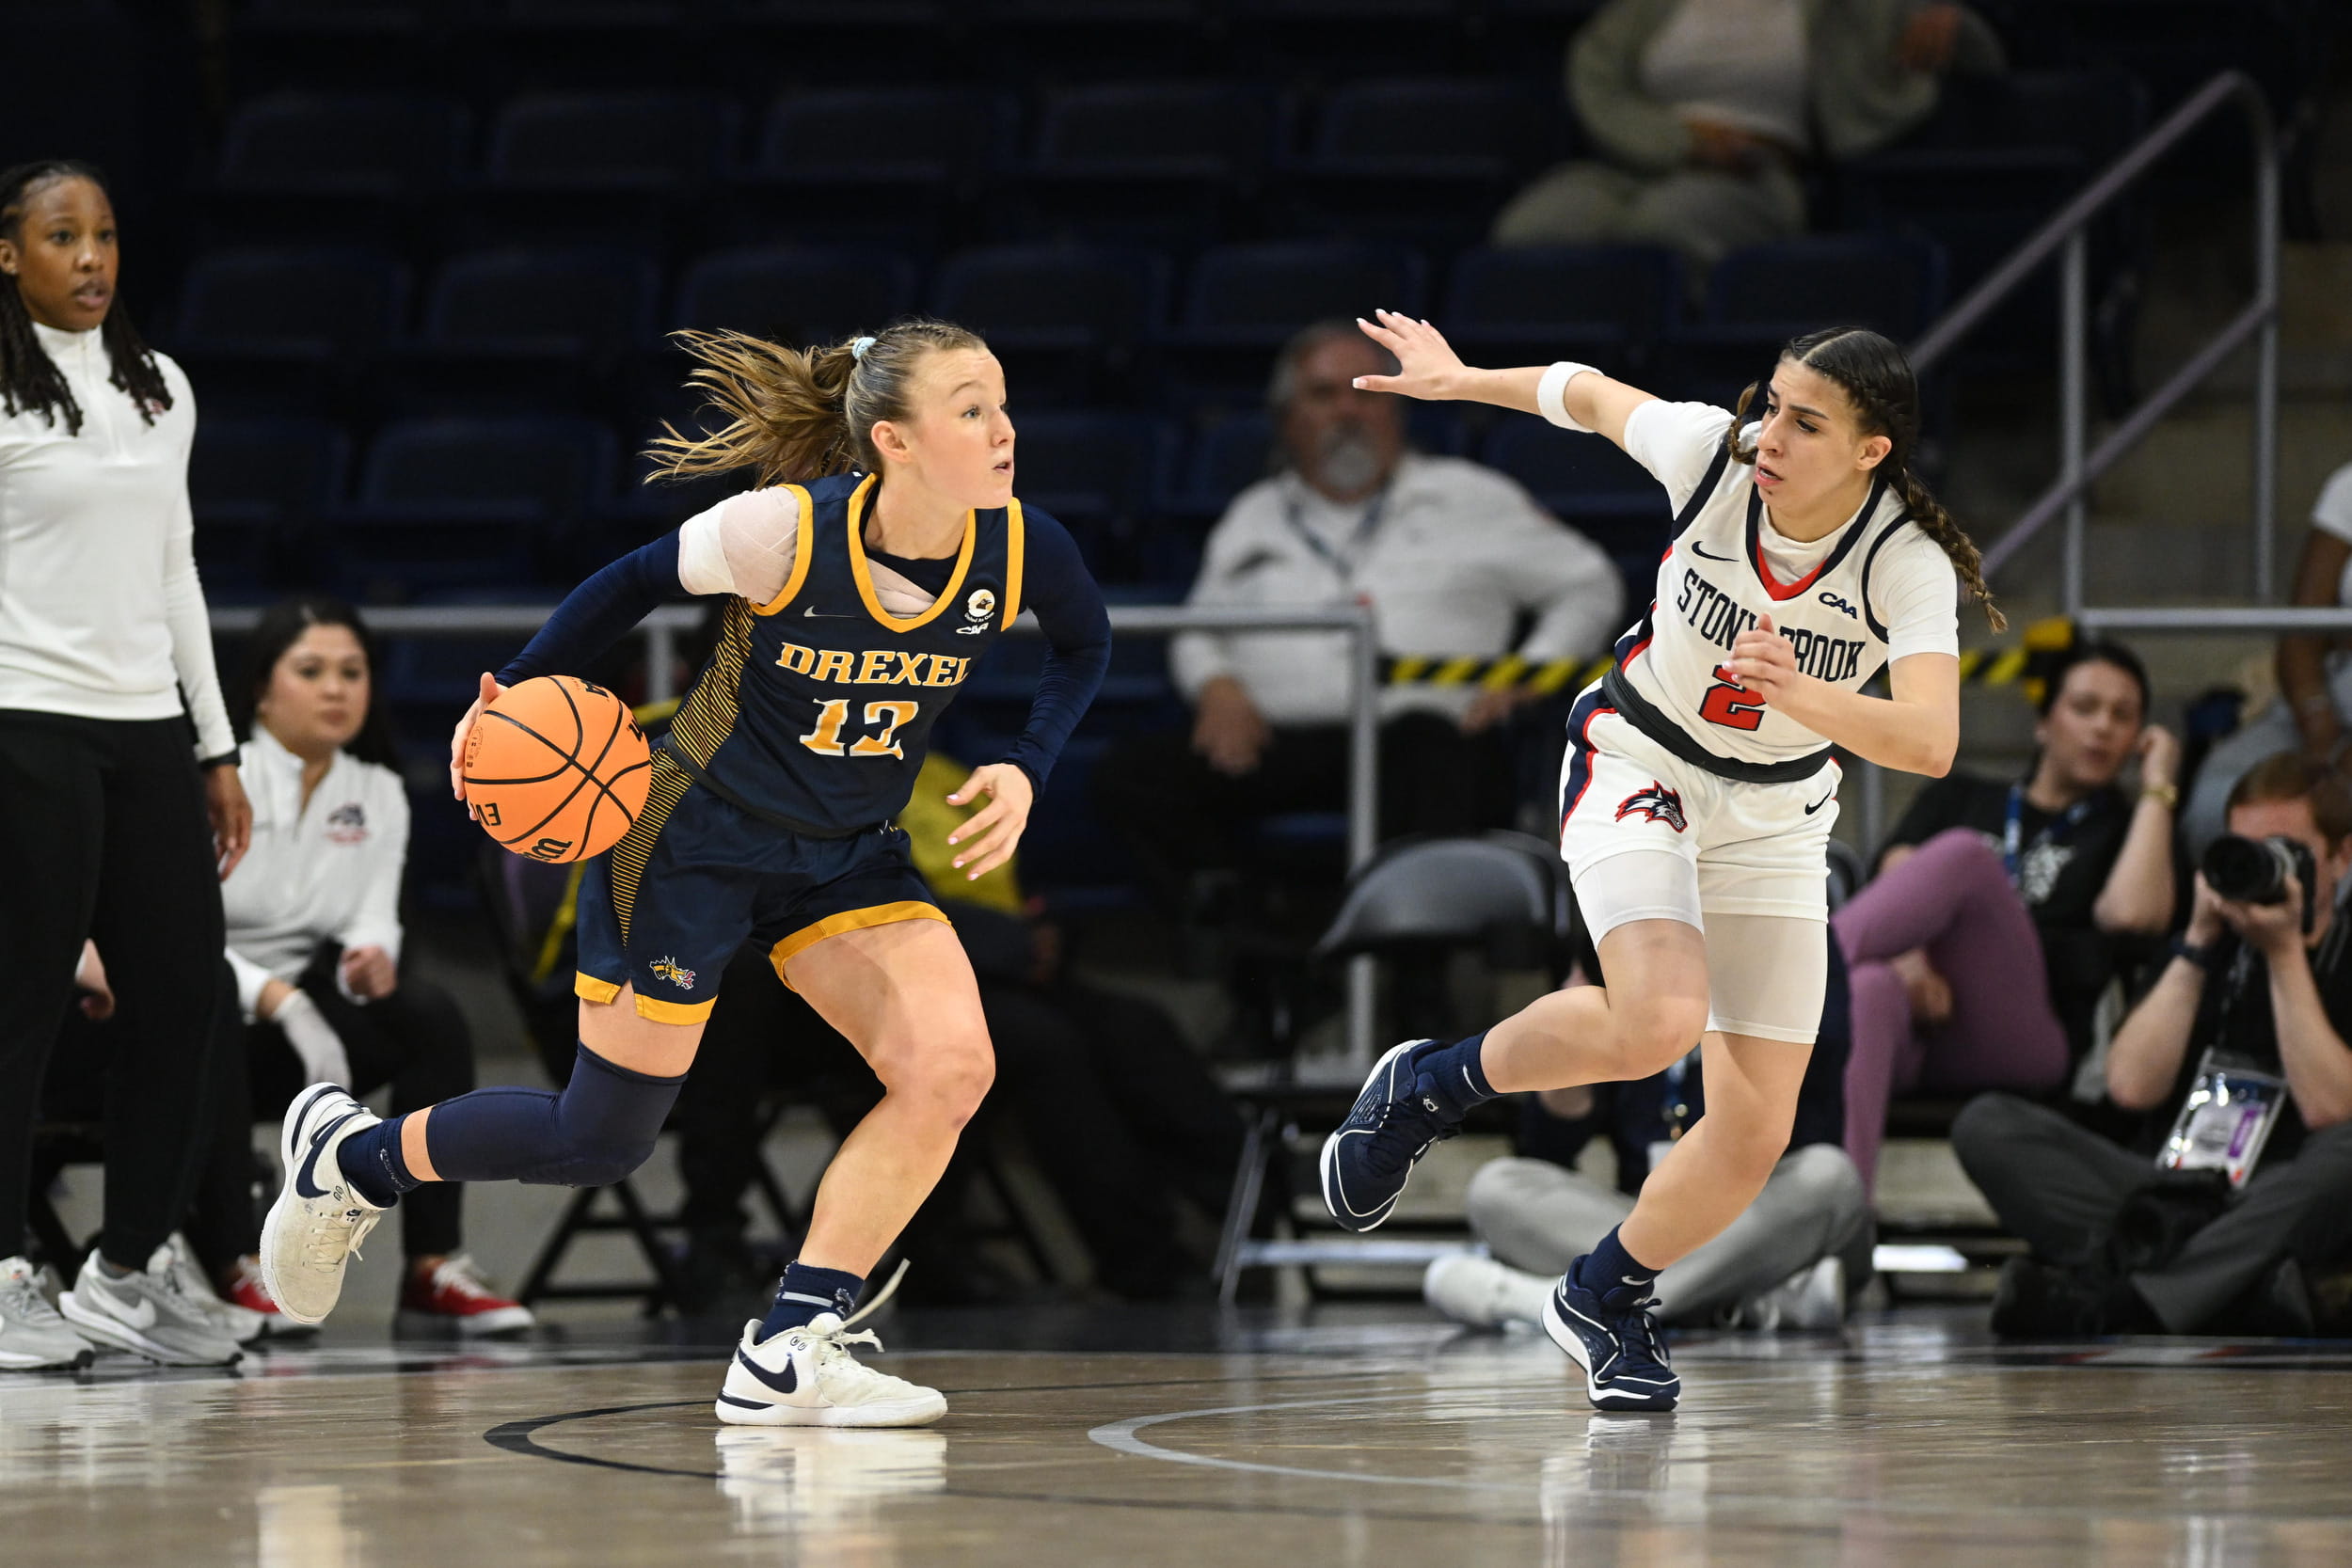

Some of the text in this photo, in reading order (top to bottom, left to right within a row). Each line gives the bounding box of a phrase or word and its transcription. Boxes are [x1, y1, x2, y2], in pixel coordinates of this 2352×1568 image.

[1818, 592, 1858, 620] CAA
[1698, 663, 1767, 732] 2
[799, 697, 919, 761] 12
[471, 802, 502, 827] EV
